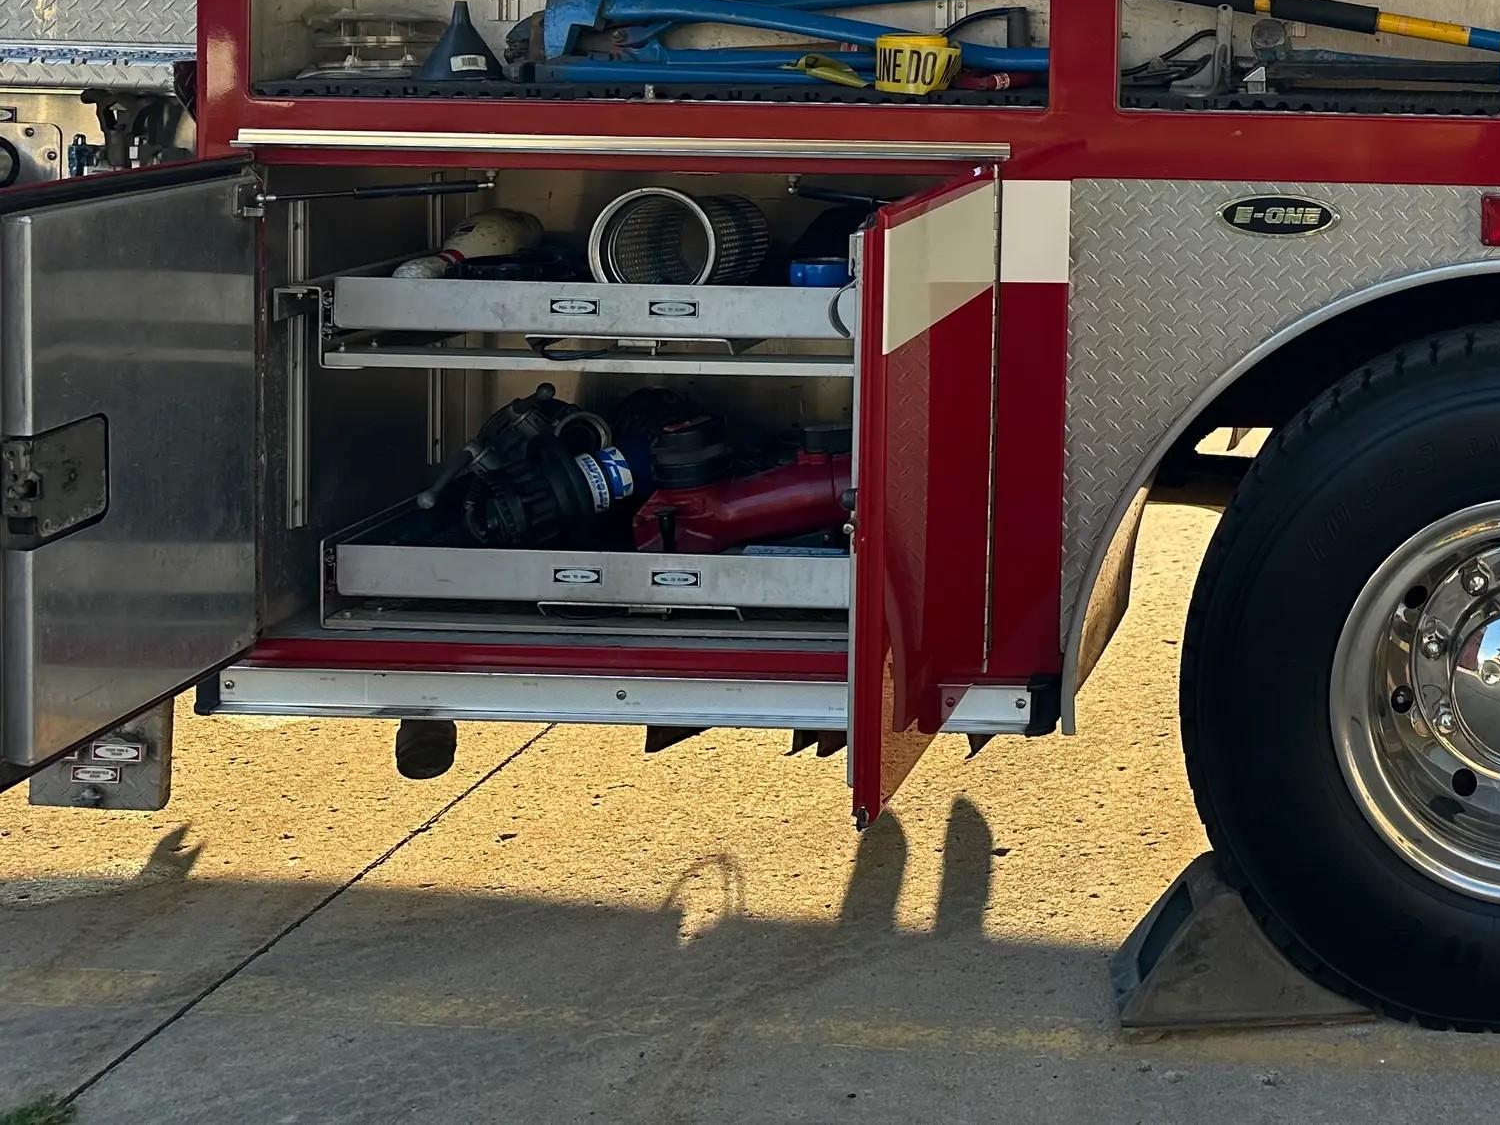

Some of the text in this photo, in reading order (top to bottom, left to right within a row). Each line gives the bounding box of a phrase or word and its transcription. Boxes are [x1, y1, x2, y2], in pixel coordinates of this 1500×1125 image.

[877, 48, 904, 83] INE
[906, 49, 938, 86] DO
[1233, 206, 1322, 225] E-ONE
